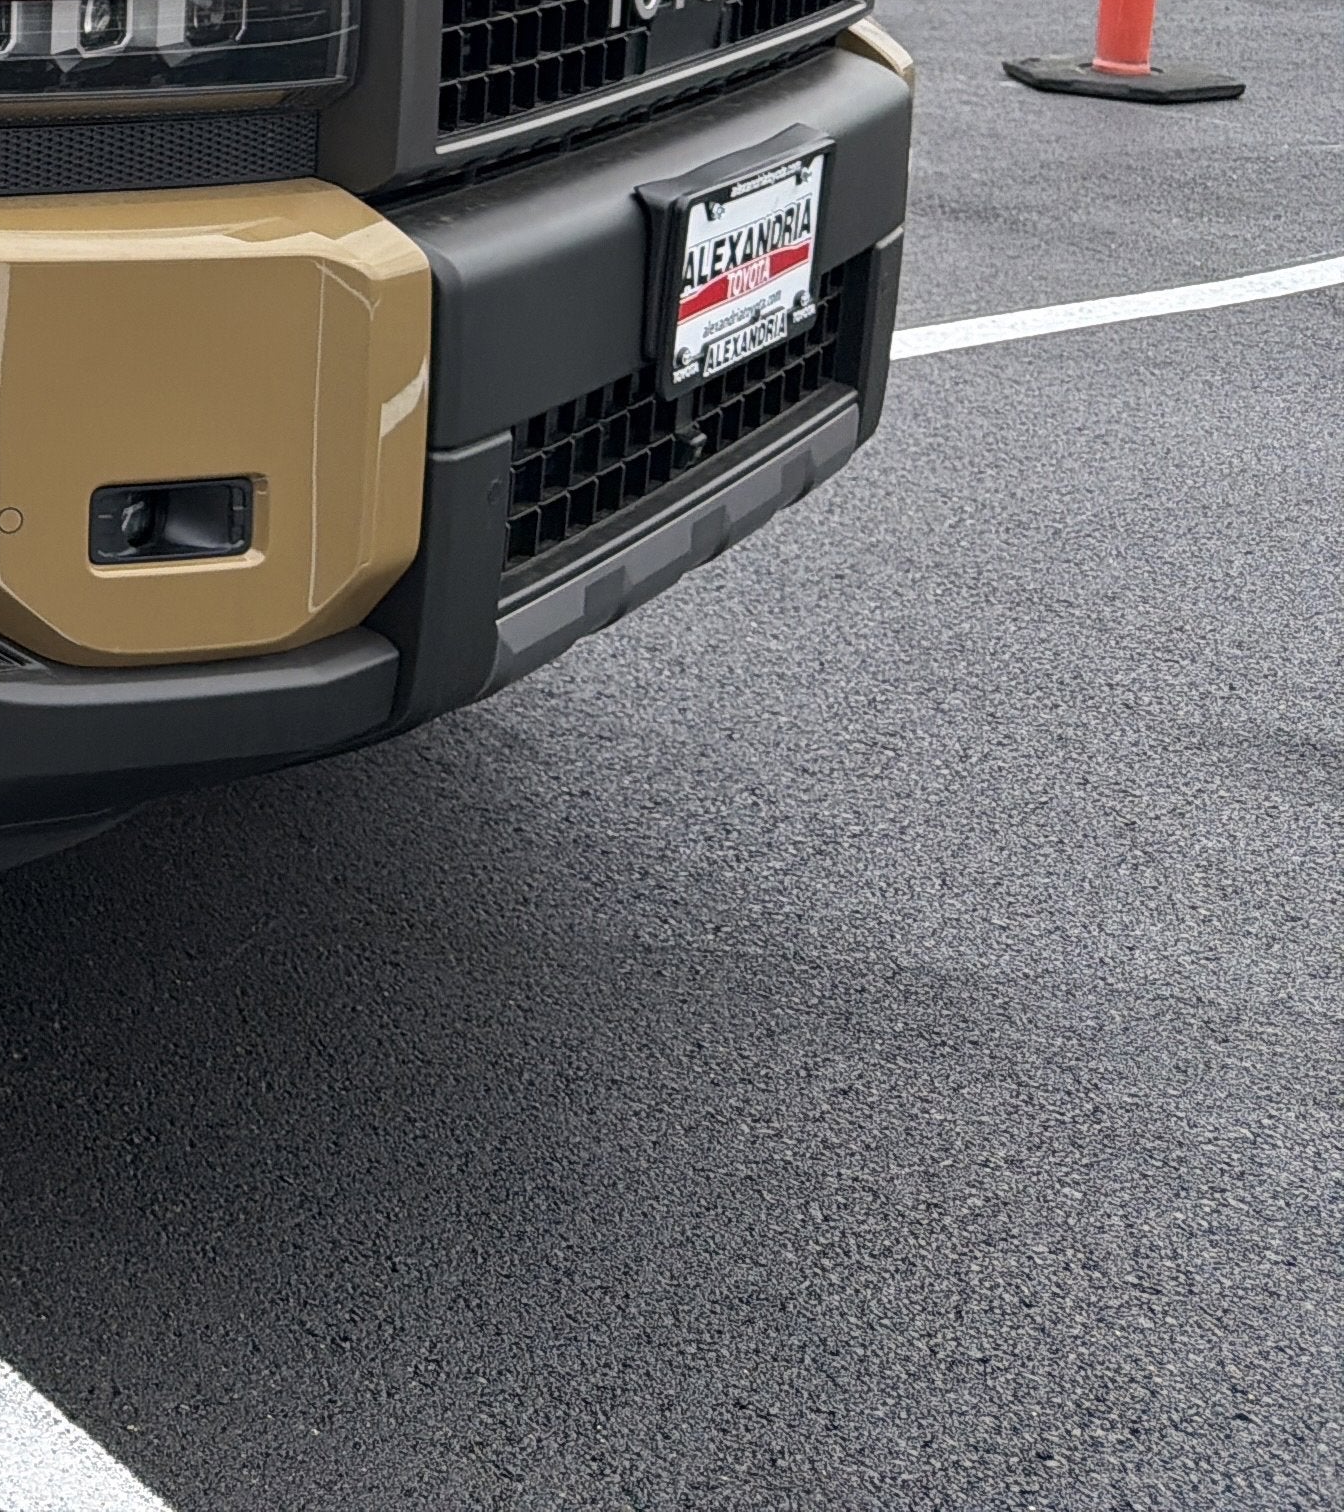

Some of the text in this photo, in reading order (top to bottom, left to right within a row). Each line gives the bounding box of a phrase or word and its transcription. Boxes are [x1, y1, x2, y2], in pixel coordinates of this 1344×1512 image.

[682, 197, 812, 287] ALEXANDRIA
[728, 260, 771, 297] TOYOTA
[703, 310, 788, 376] ALEXANDRIA
